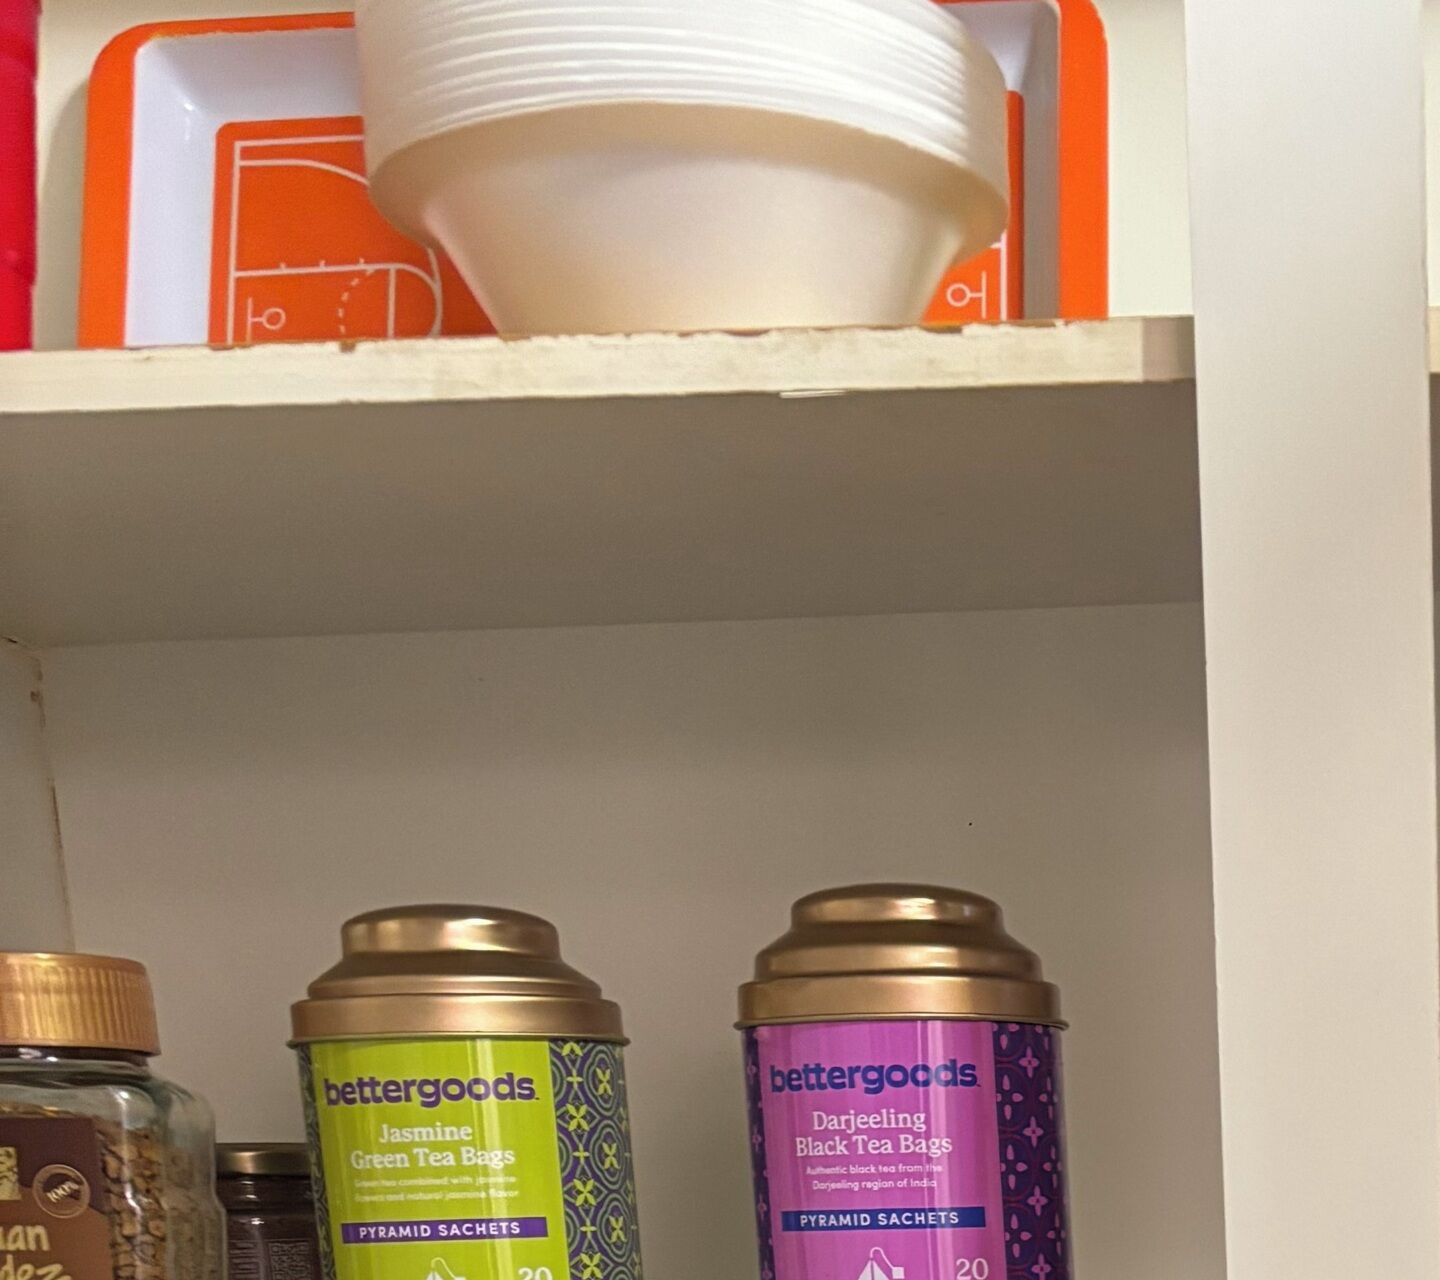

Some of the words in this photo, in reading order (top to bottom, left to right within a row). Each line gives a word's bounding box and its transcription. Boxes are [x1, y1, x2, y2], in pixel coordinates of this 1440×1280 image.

[769, 1058, 979, 1095] bettergoods
[323, 1071, 536, 1109] bettergoods
[812, 1108, 927, 1134] Darjeeling
[378, 1122, 473, 1144] Jasmine
[795, 1136, 850, 1157] Black
[852, 1134, 894, 1155] Tea
[899, 1133, 953, 1158] Bags
[350, 1150, 410, 1169] Green
[412, 1147, 456, 1168] Tea
[460, 1146, 516, 1169] Bags
[849, 1164, 876, 1174] black
[878, 1164, 896, 1173] tea
[898, 1163, 923, 1173] from
[812, 1179, 860, 1192] Darjeeling
[861, 1178, 895, 1191] region
[896, 1178, 908, 1188] of
[910, 1177, 937, 1188] India
[358, 1224, 432, 1239] PYRAMID
[438, 1221, 521, 1237] SACHETS
[799, 1213, 871, 1228] PYRAMID
[877, 1211, 960, 1227] SACHETS
[955, 1257, 990, 1280] 20
